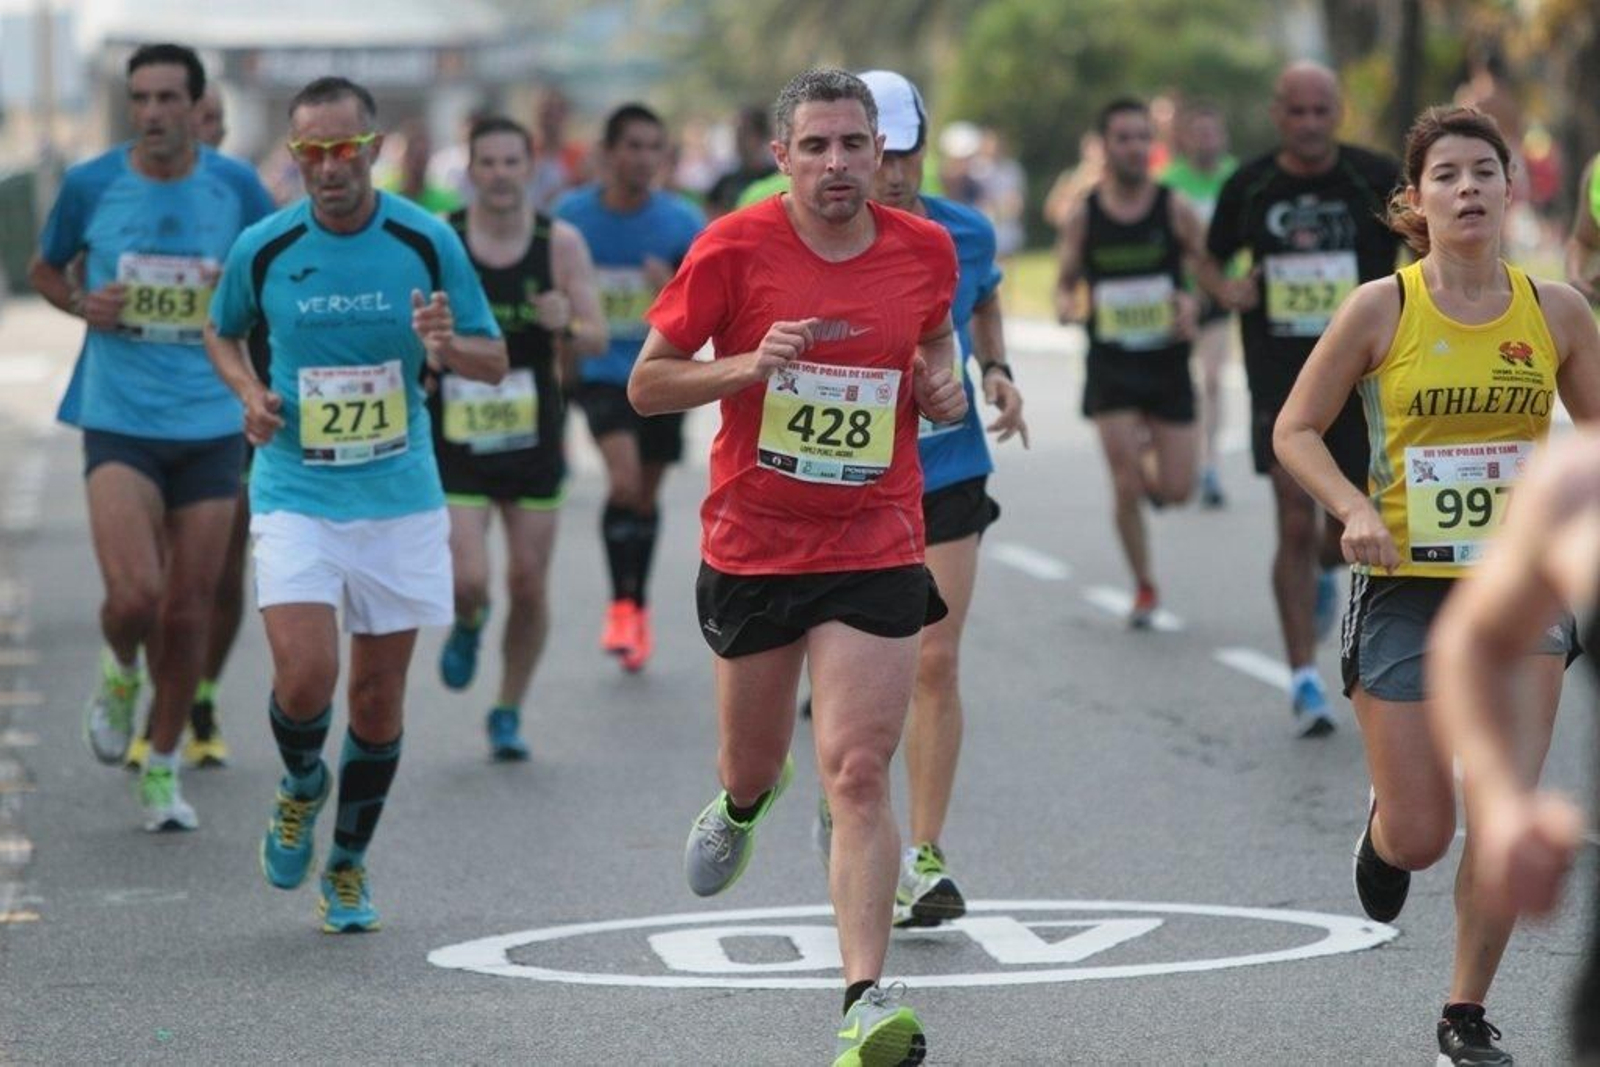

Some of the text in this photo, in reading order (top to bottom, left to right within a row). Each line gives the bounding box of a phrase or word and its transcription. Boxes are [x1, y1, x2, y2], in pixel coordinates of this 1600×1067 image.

[135, 286, 196, 318] 863
[297, 290, 391, 314] VERXEL
[321, 400, 390, 434] 271
[1407, 386, 1553, 417] ATHLETICS
[787, 404, 872, 449] 428
